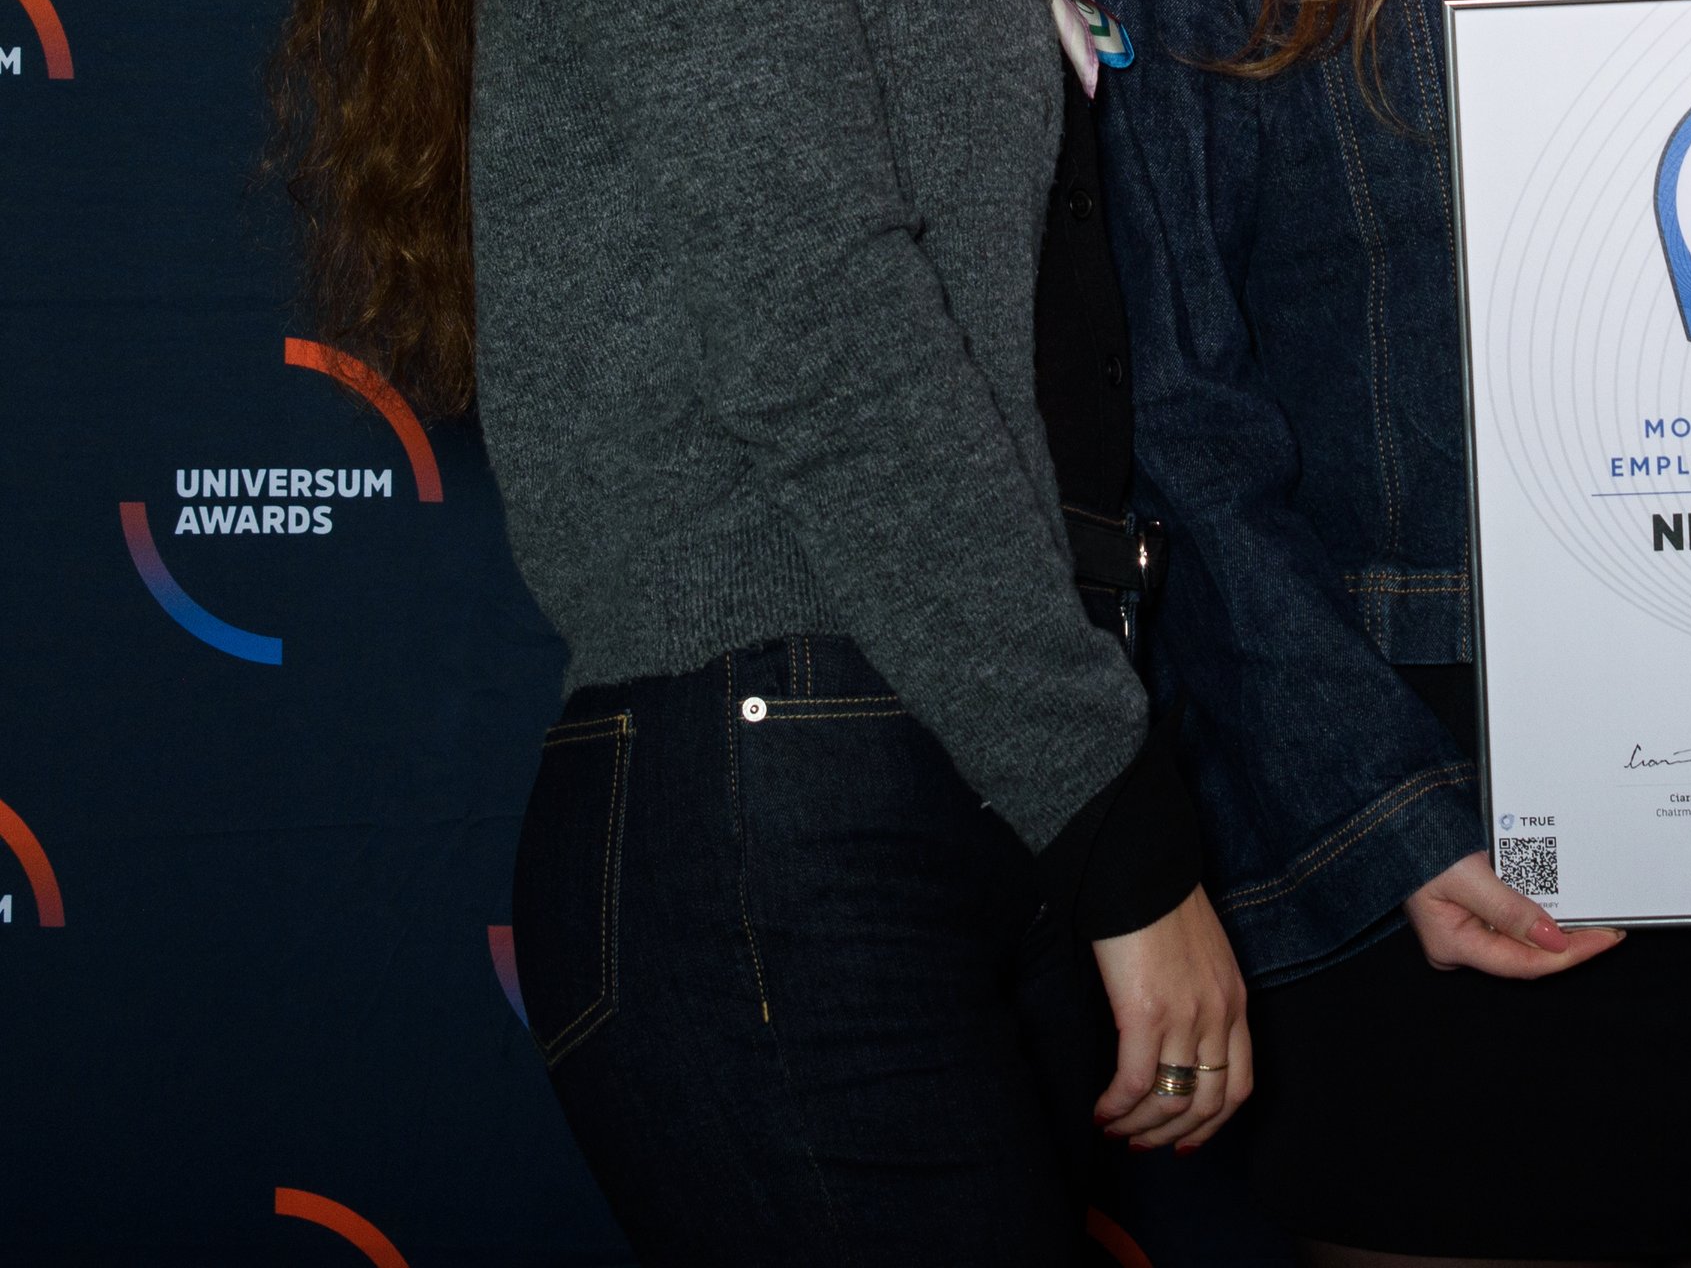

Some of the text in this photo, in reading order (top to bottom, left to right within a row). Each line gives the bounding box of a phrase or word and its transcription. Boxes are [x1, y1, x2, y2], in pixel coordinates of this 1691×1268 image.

[176, 468, 392, 498] UNIVERSUM
[174, 505, 333, 535] AWARDS
[1520, 815, 1556, 827] TRUE
